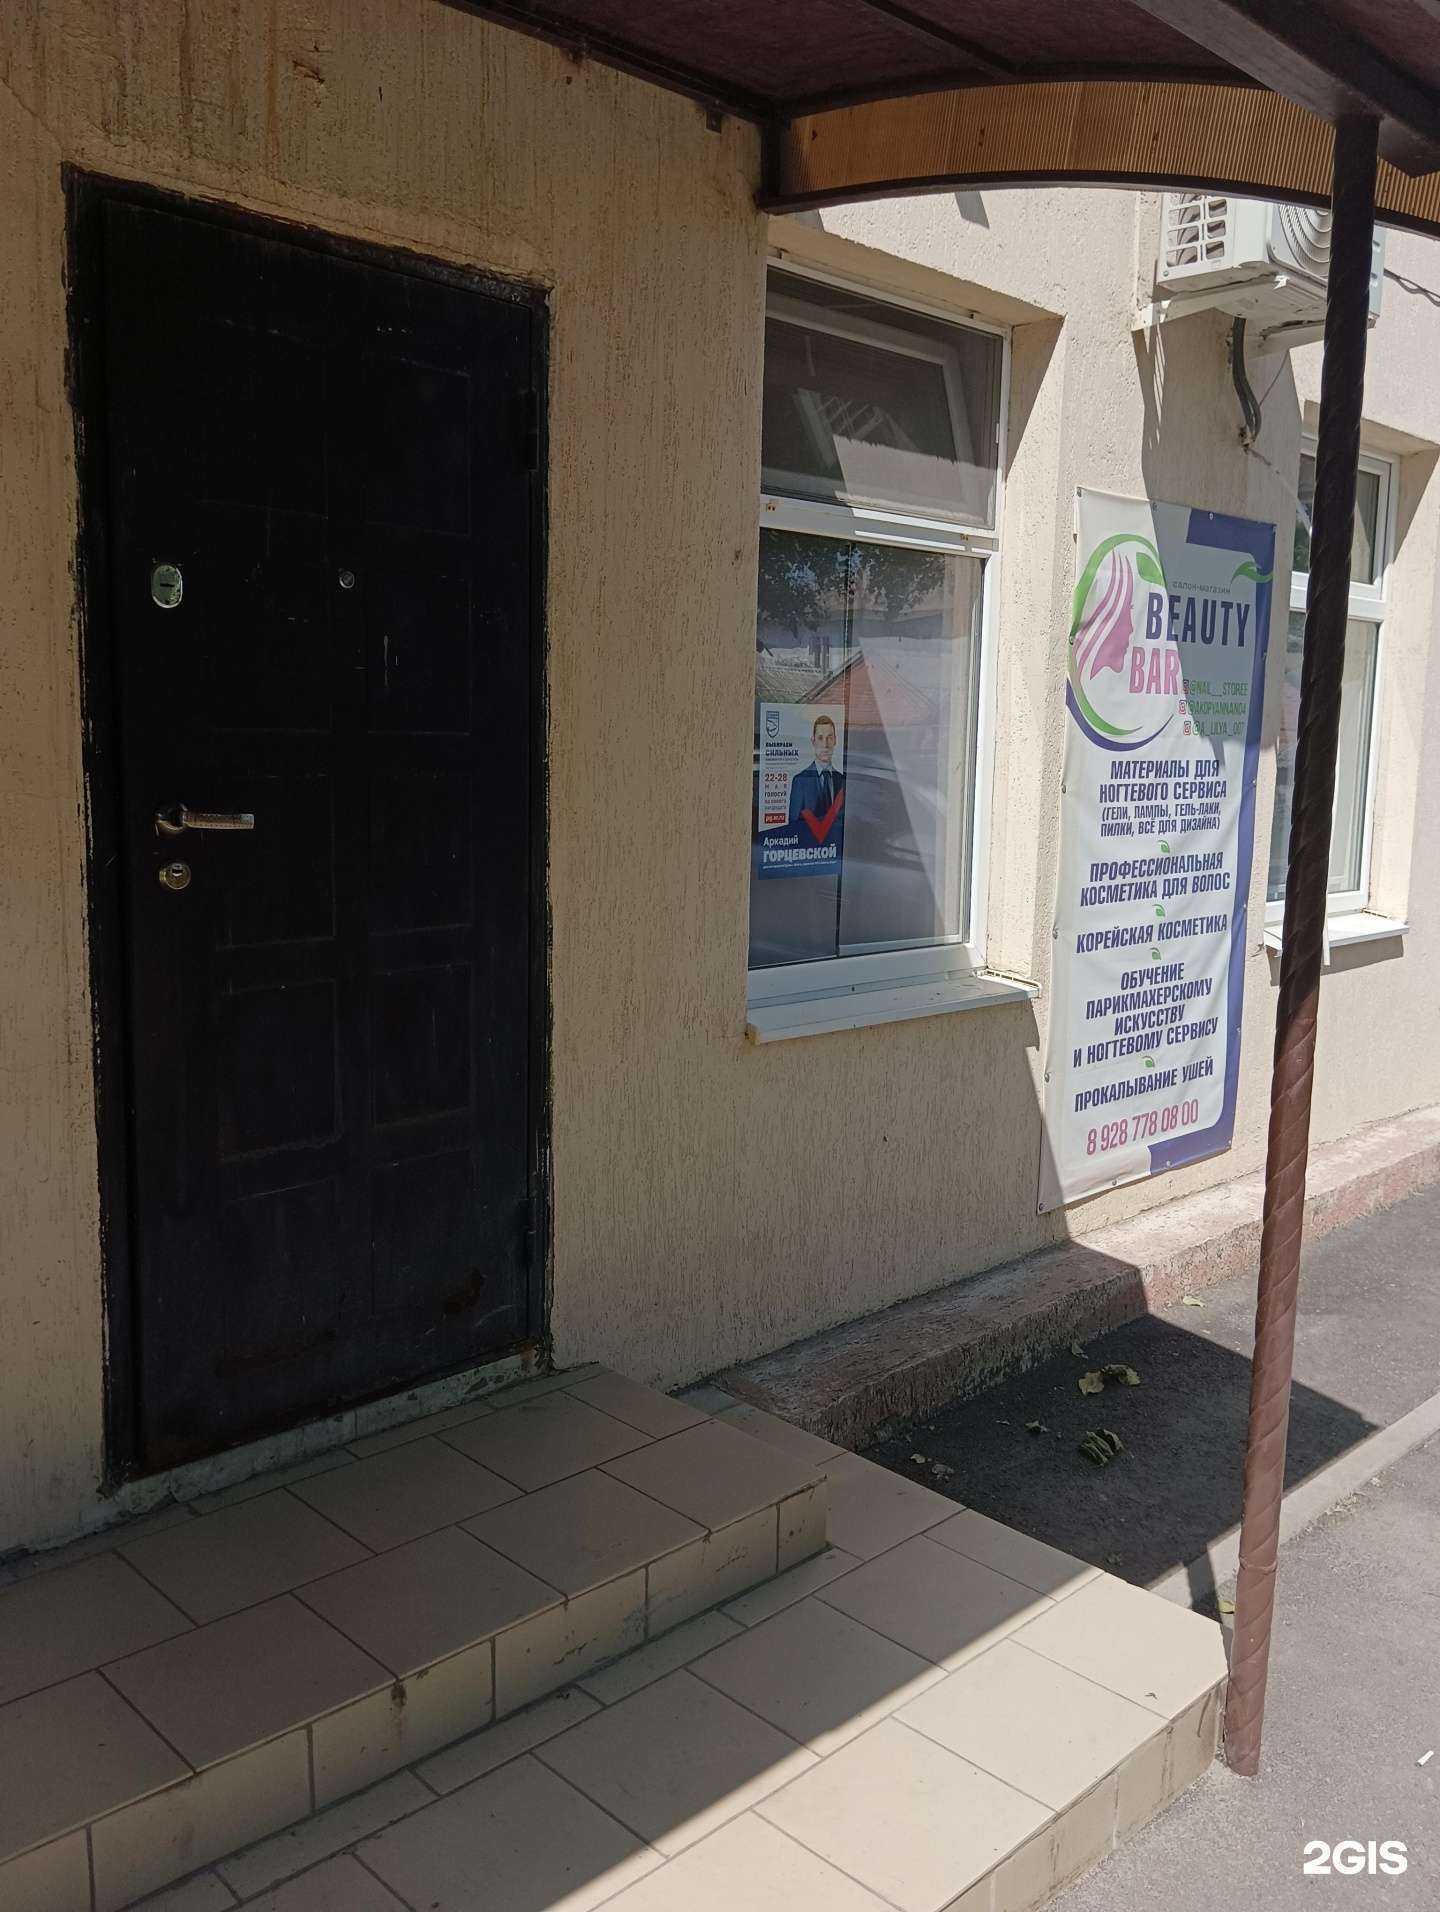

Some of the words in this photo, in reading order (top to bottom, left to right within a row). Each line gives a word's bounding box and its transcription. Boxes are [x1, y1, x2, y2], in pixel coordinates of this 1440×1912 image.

[1172, 581, 1231, 593] салон-магазин
[1146, 592, 1250, 648] BEAUTY
[1129, 647, 1180, 695] BAR
[765, 749, 799, 757] СИЛЬНЫХ
[765, 773, 788, 782] 22-28
[1110, 759, 1189, 780] МАТЕРИАЛЫ
[1194, 759, 1220, 781] ДЛЯ
[1099, 782, 1169, 803] НОГТЕВОГО
[1173, 780, 1227, 800] СЕРВИСА
[1100, 821, 1135, 837] ПИЛКИ,
[1138, 818, 1156, 835] ВСЁ
[1158, 820, 1177, 835] ДЛЯ
[1180, 816, 1220, 833] ДИЗАЙНА)
[1102, 806, 1132, 822] (ГЕЛИ,
[1133, 804, 1171, 819] ЛАМПЫ,
[1175, 802, 1221, 817] ГЕЛЬ-ЛАКИ,
[763, 835, 799, 848] Аркадий
[763, 843, 837, 863] ГОРЦЕВСКОЙ
[1089, 852, 1224, 882] ПРОФЕССИОНАЛЬНАЯ
[1080, 879, 1158, 907] КОСМЕТИКА
[1162, 877, 1187, 900] ДЛЯ
[1191, 872, 1231, 894] ВОЛОС
[1076, 924, 1154, 953] КОРЕЙСКАЯ
[1157, 914, 1228, 941] КОСМЕТИКА
[1120, 962, 1185, 991] ОБУЧЕНИЕ
[1085, 978, 1213, 1020] ПАРИКМАХЕРСКОМУ
[1114, 1005, 1185, 1036] ИСКУССТВУ
[1073, 1048, 1082, 1068] И
[1087, 1030, 1163, 1065] НОГТЕВОМУ
[1167, 1017, 1218, 1045] СЕРВИСУ
[1074, 1068, 1178, 1112] ПРОКАЛЫВАНИЕ
[1182, 1056, 1214, 1084] УШЕЙ
[1086, 1128, 1097, 1155] 8
[1101, 1119, 1128, 1151] 928
[1132, 1110, 1157, 1142] 778
[1161, 1104, 1178, 1132] 08
[1182, 1099, 1199, 1126] 00
